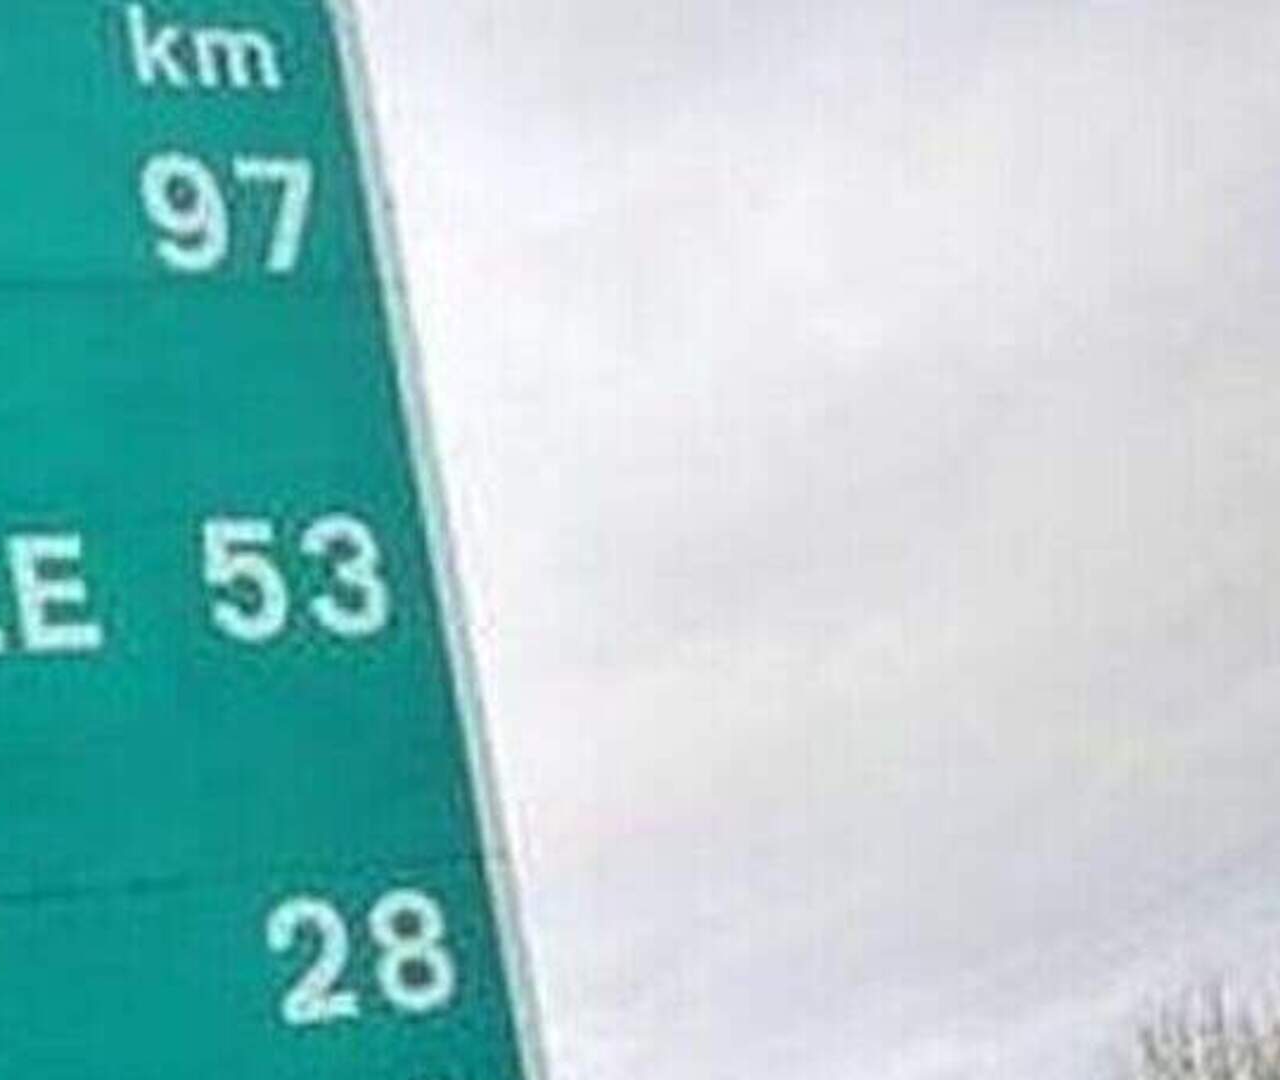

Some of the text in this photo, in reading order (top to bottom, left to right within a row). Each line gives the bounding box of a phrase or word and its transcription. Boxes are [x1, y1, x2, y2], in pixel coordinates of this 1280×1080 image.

[128, 4, 280, 87] km
[142, 153, 312, 271] 97
[203, 516, 387, 640] 53
[267, 890, 455, 1023] 28
